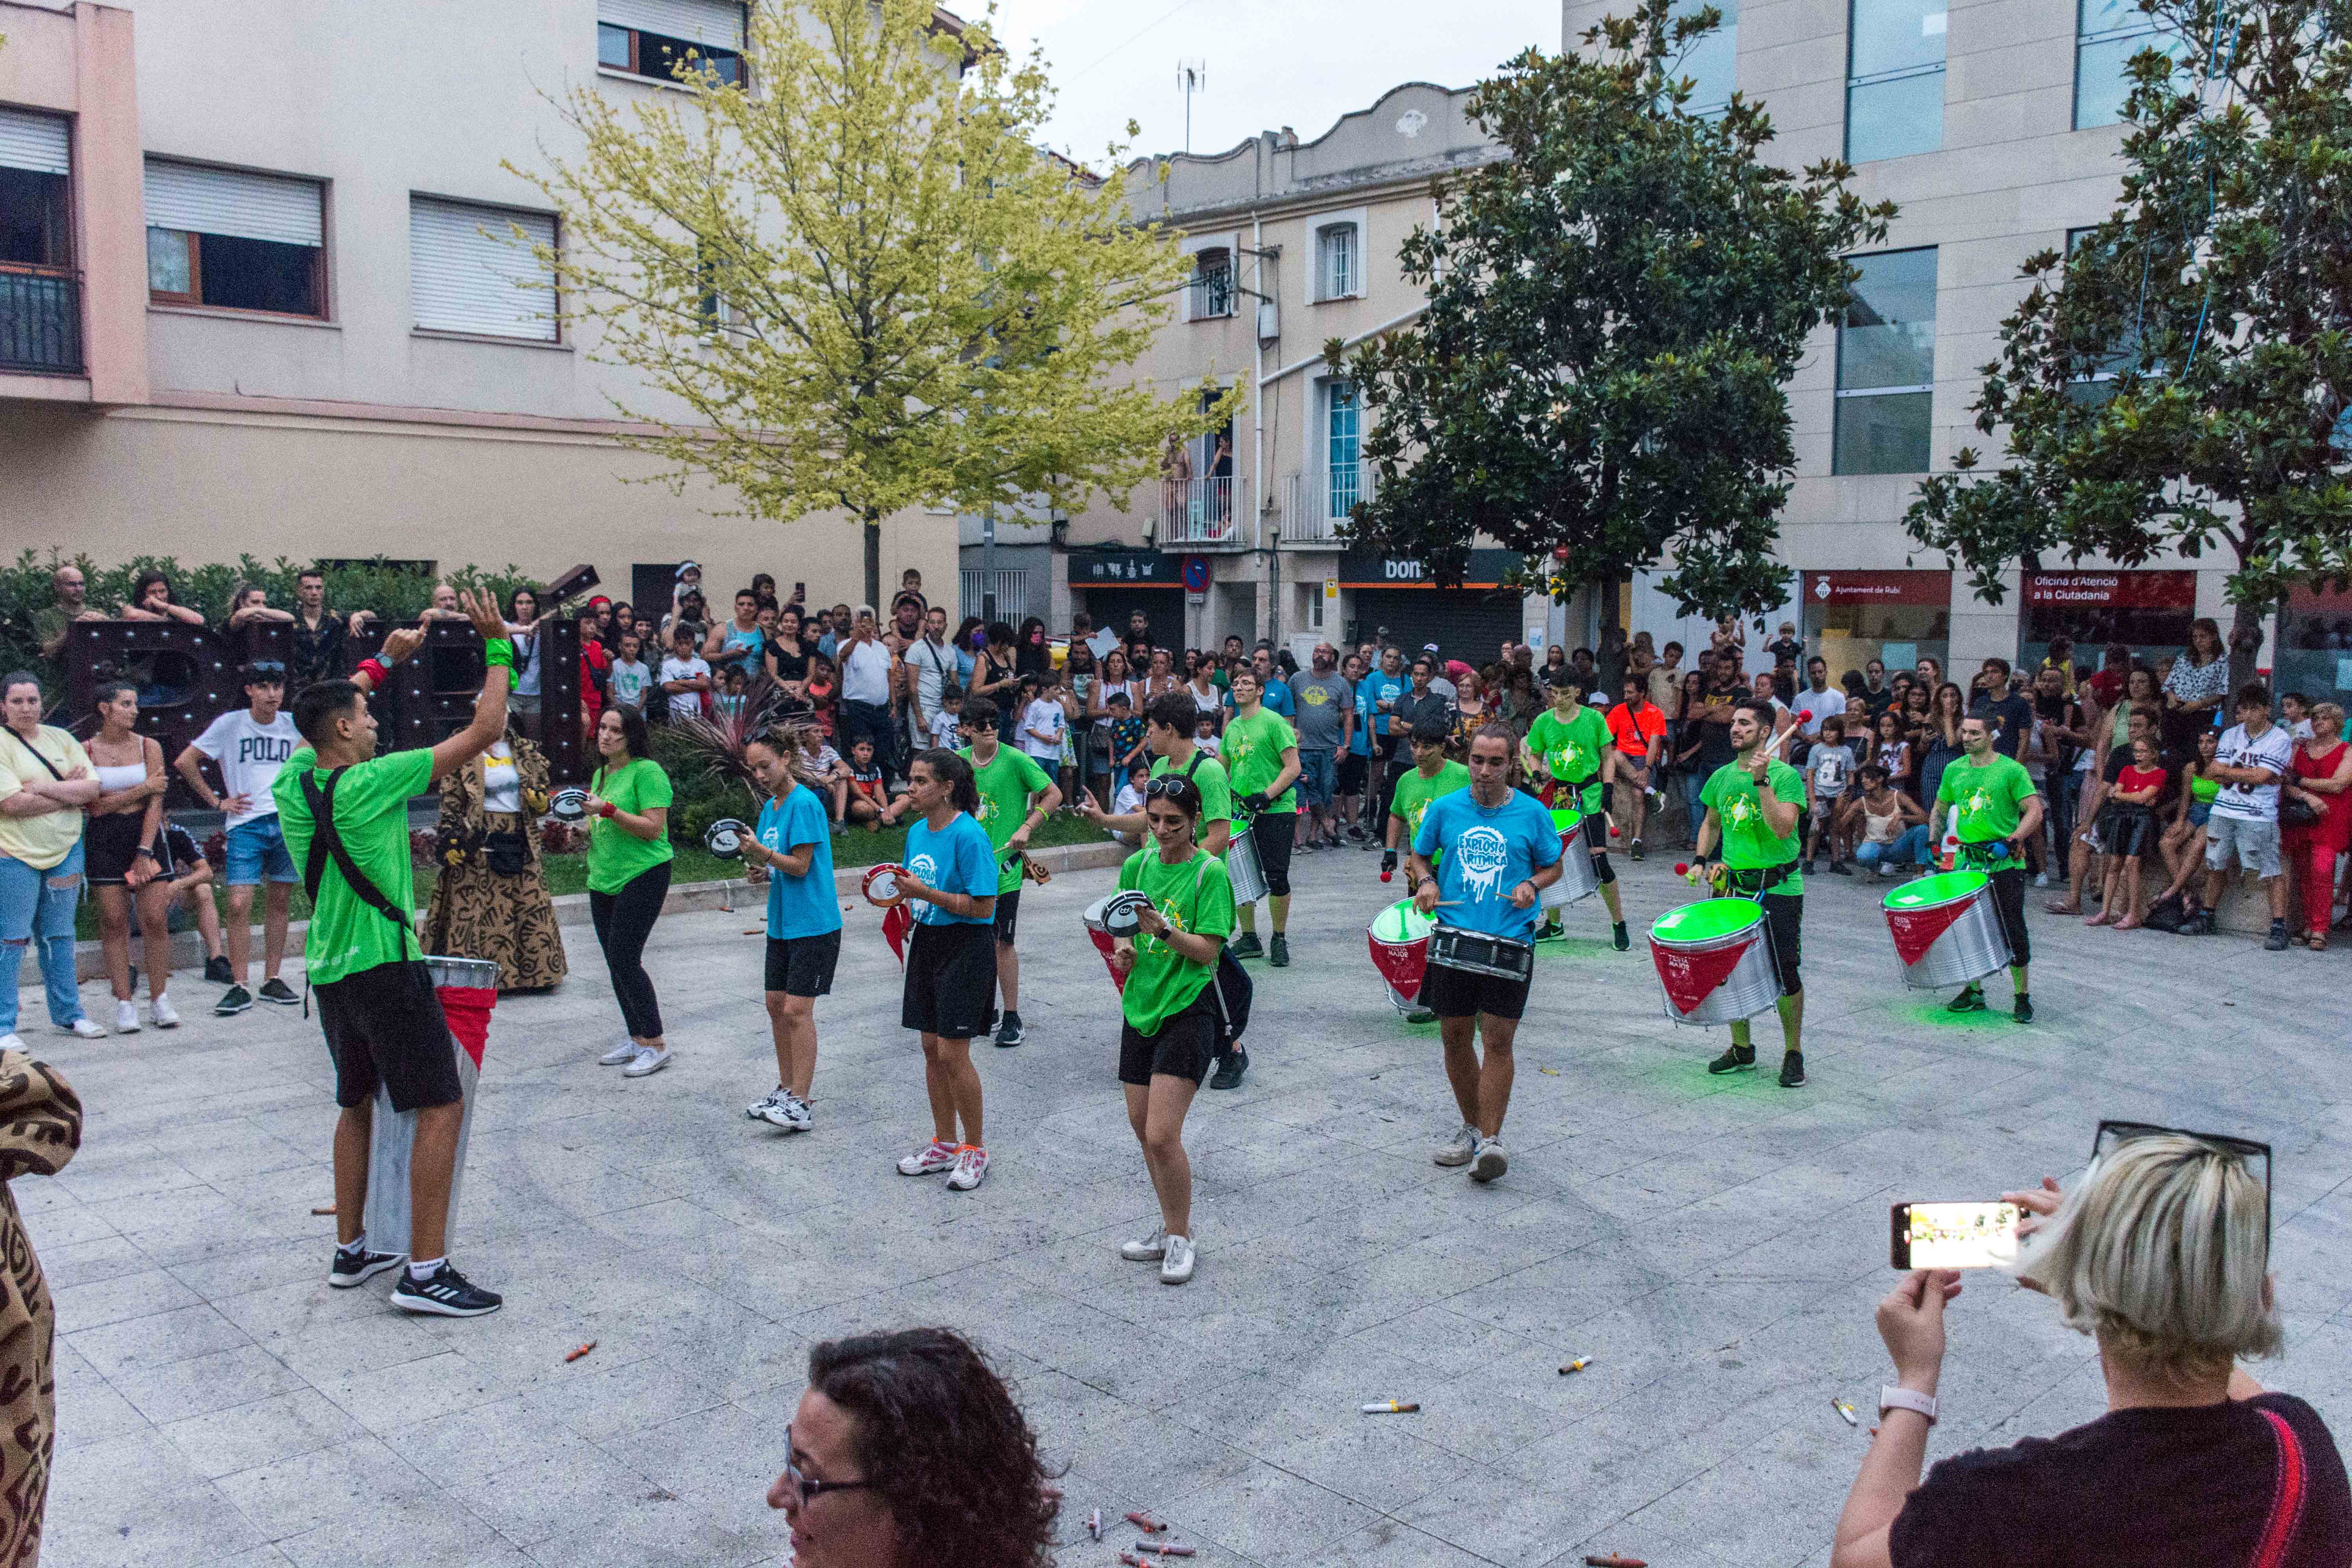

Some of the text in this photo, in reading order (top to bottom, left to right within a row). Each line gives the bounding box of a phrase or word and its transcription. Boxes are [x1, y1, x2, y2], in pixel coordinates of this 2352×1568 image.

[2035, 576, 2118, 586] Oficina d'Atenció
[2043, 590, 2053, 599] la
[2055, 590, 2109, 600] Ciutadania
[239, 736, 291, 763] POLO
[1459, 835, 1508, 853] EXPLOSIÓ
[1388, 950, 1408, 958] MAJOR
[1669, 960, 1690, 971] MAJOR
